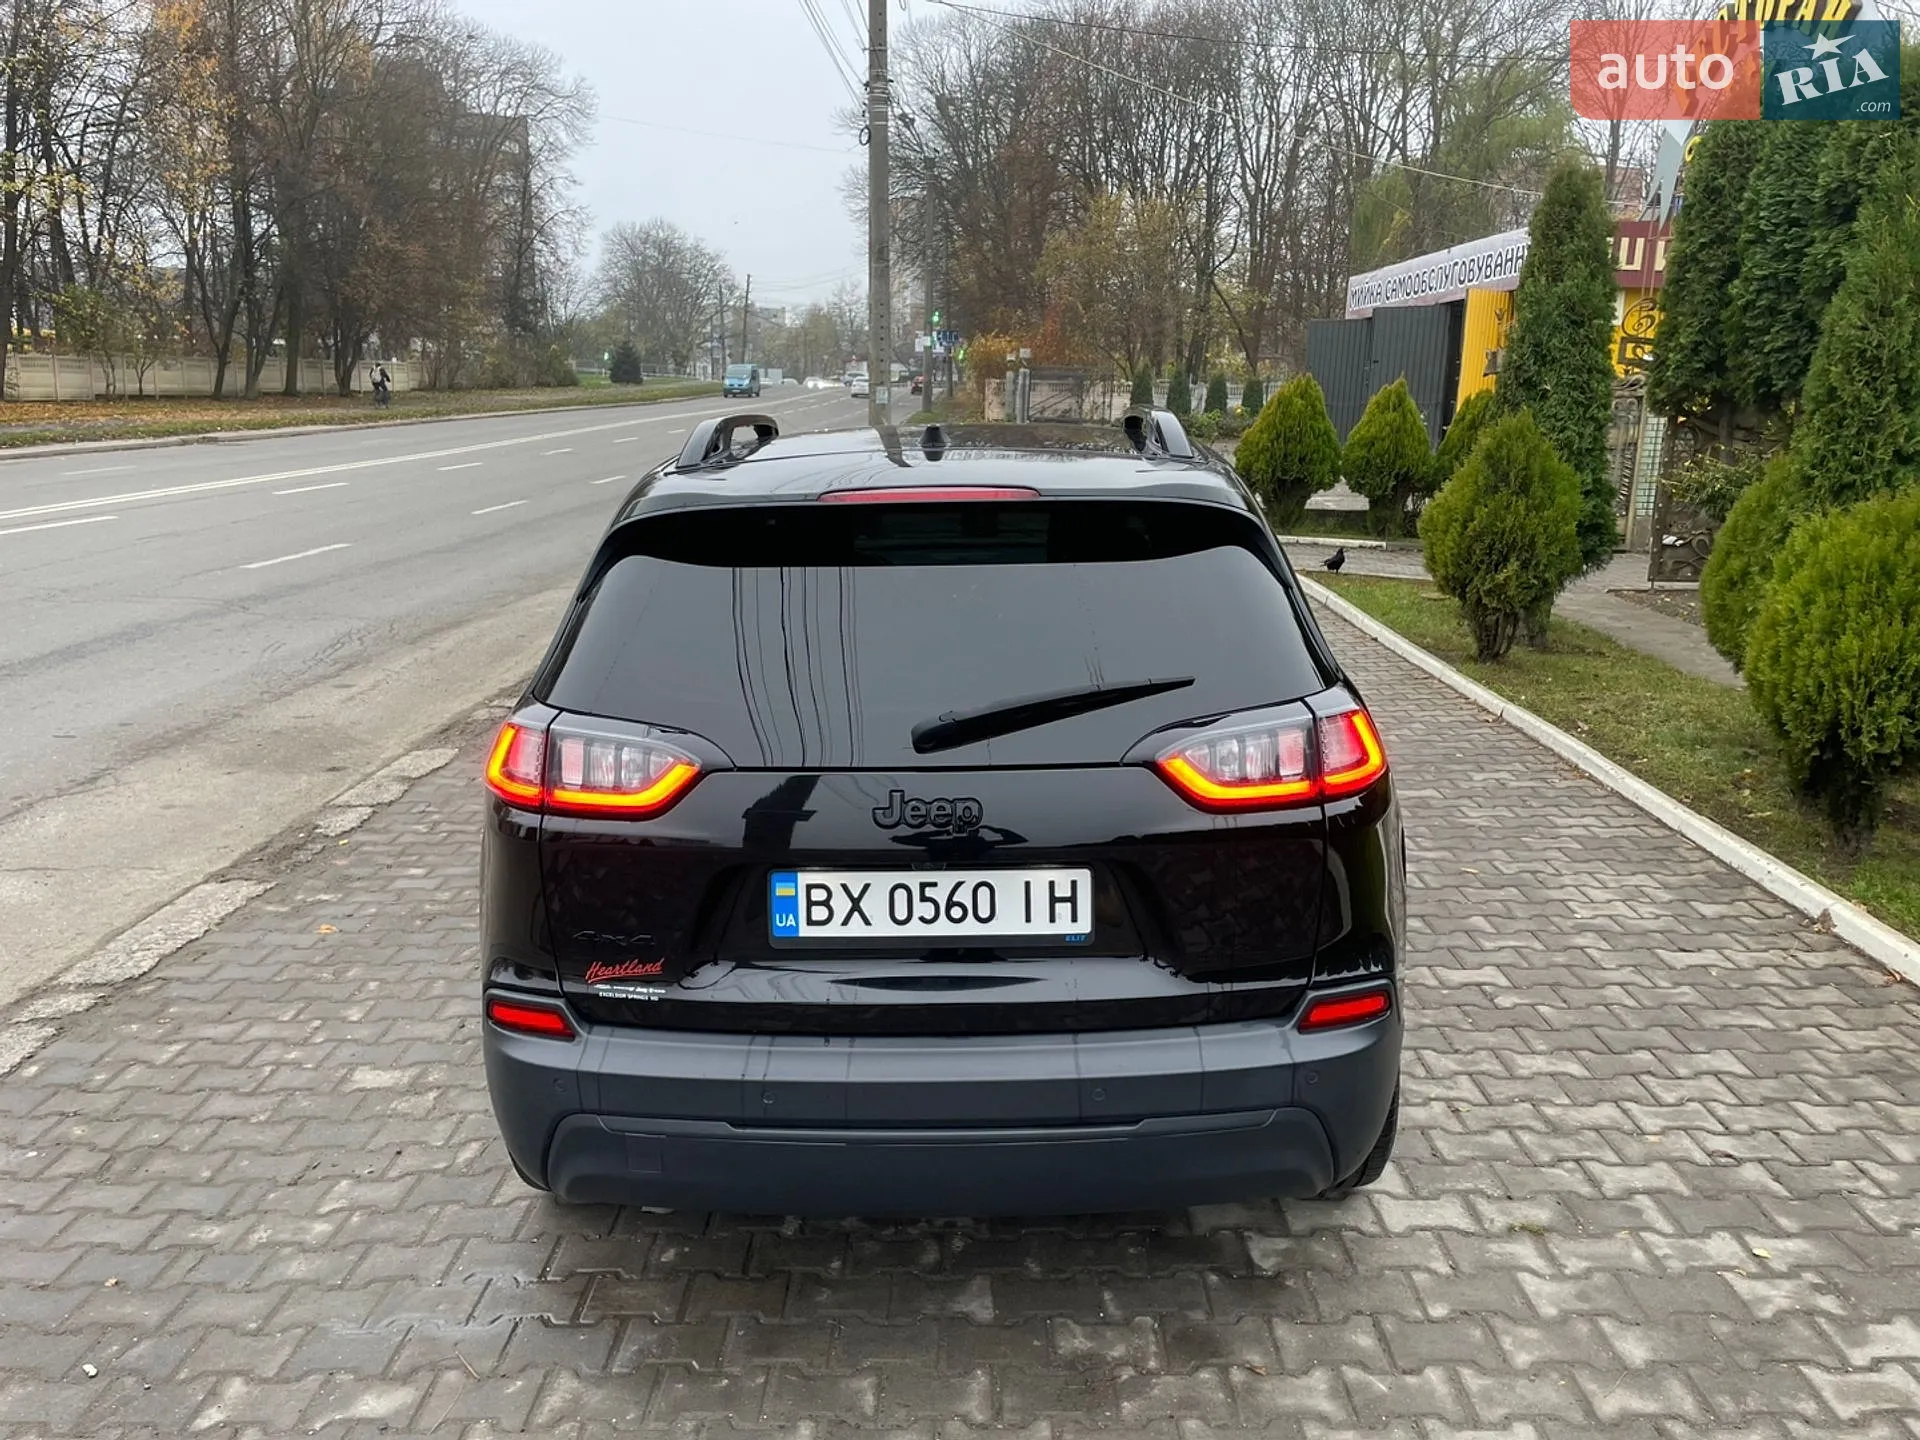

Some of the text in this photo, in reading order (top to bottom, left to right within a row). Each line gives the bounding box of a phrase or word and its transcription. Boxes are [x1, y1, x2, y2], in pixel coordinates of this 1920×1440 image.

[1349, 243, 1528, 310] МИЙКА САМООБСЛУГОВУВАНН
[872, 789, 984, 834] Jeep
[775, 914, 796, 927] UA
[805, 879, 1079, 927] BX 0560 IH
[584, 957, 665, 981] Heartland
